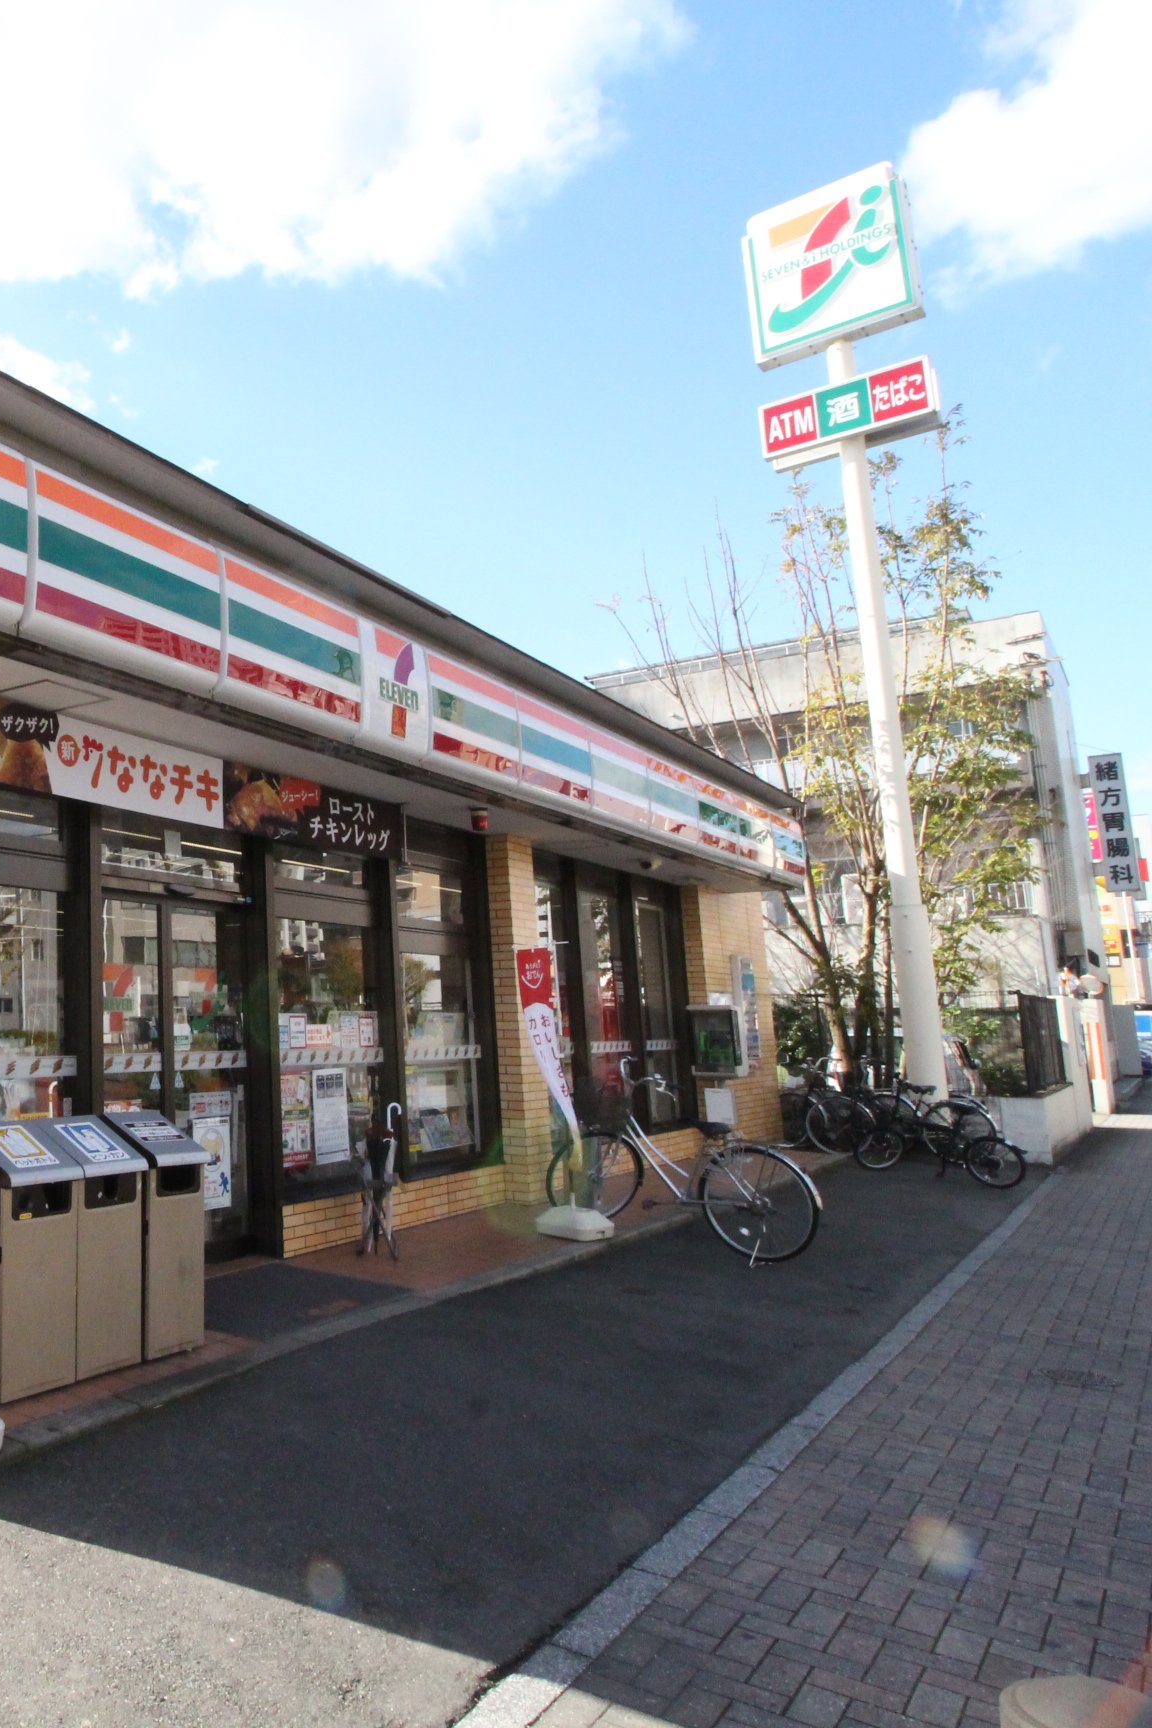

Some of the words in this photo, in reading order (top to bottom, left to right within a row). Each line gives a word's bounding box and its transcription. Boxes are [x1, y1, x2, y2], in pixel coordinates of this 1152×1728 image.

[761, 258, 800, 282] SEVEN
[820, 223, 893, 258] HOLDINGS
[826, 391, 859, 427] 酒
[872, 374, 926, 413] たばこ
[768, 406, 814, 443] ATM
[1, 715, 54, 734] ザクザク!
[60, 739, 76, 762] 新
[281, 789, 319, 802] ジューシー!
[329, 797, 375, 825] ロースト
[309, 815, 390, 851] チキンレッグ
[1095, 760, 1134, 885] 緒方胃腸科
